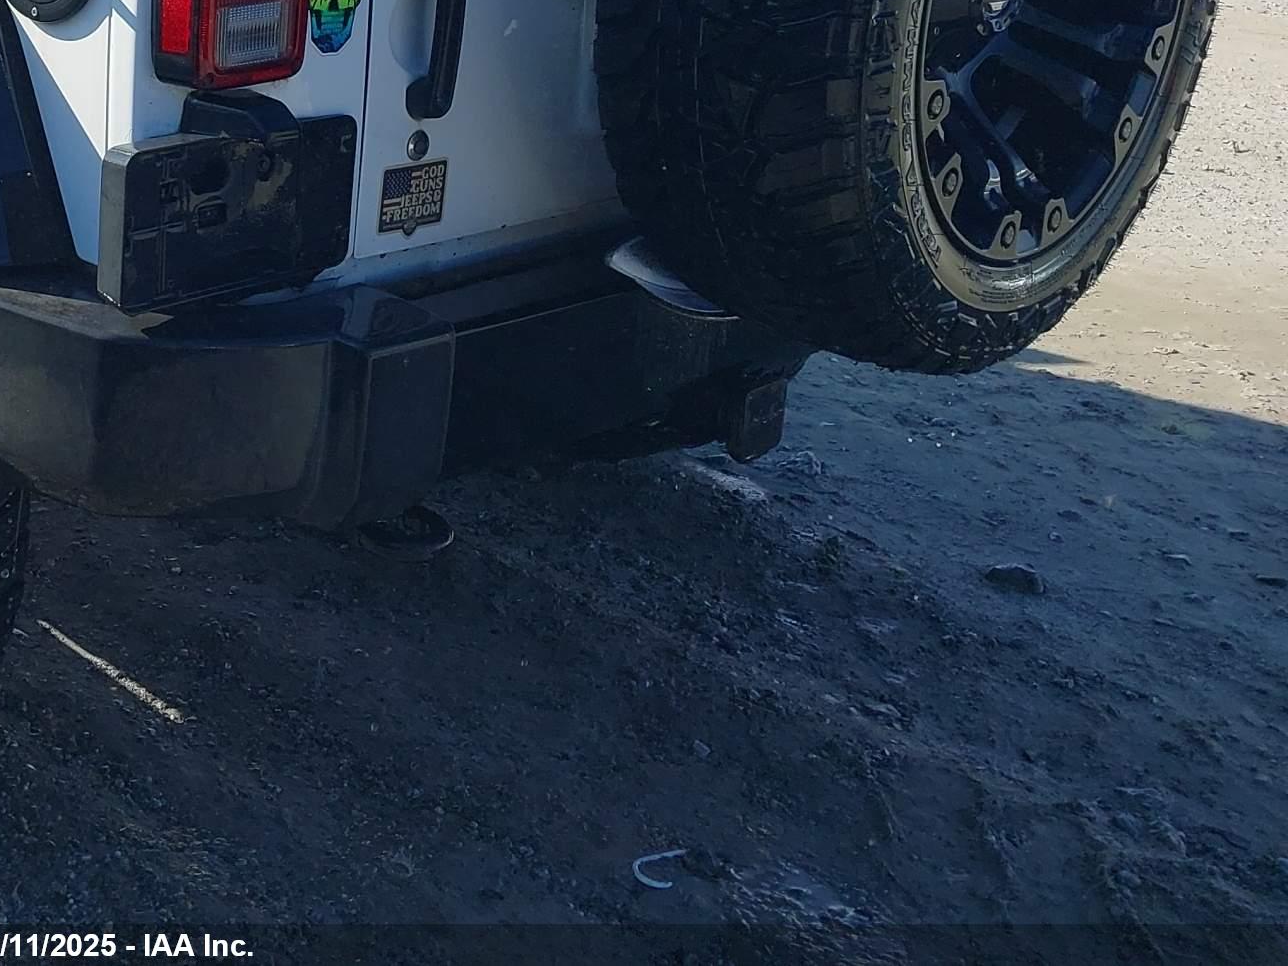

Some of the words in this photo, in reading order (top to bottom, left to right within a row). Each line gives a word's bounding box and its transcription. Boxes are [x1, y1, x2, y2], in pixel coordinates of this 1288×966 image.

[422, 164, 445, 179] GOD
[412, 176, 444, 193] GUNS
[386, 201, 441, 223] FREEDOM
